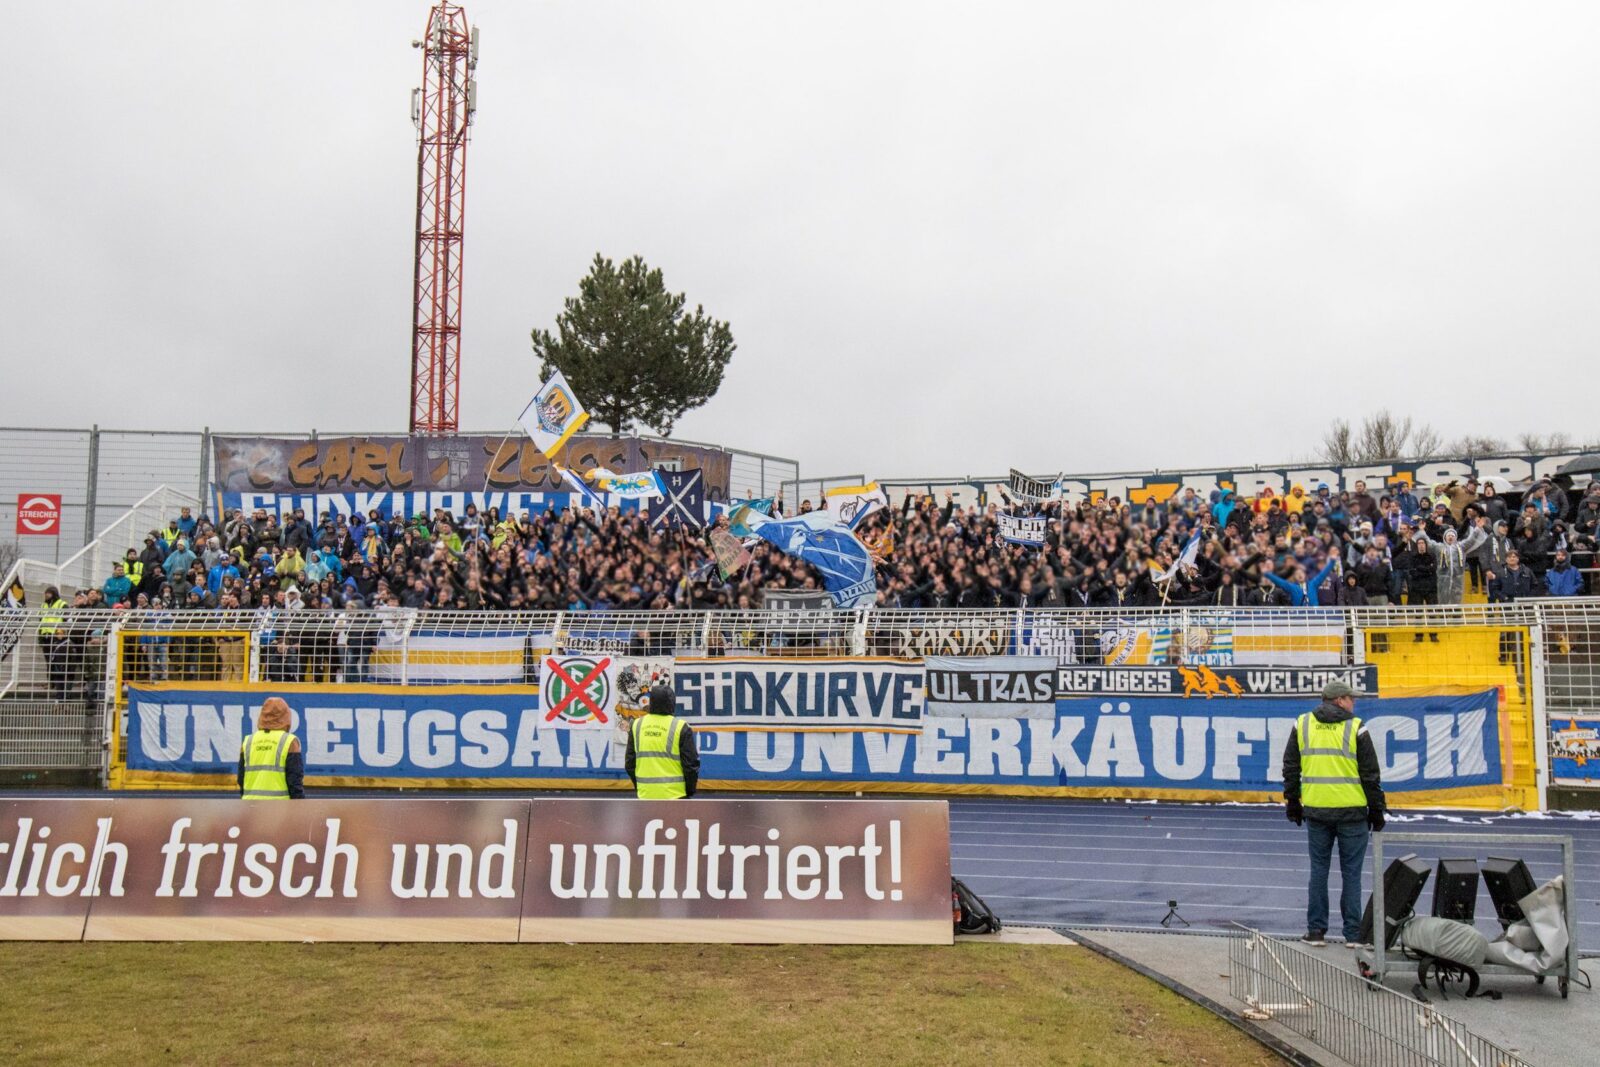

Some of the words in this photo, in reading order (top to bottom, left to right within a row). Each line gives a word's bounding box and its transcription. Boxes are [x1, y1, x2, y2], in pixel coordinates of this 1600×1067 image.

[288, 442, 413, 490] CARL
[19, 510, 58, 518] STREICHER
[674, 671, 924, 719] SÜDKURVE
[930, 672, 1053, 702] ULTRAS
[1058, 669, 1172, 692] REFUGEES
[1247, 669, 1367, 692] WELCOME
[138, 702, 627, 770] UNEUGSAM
[746, 702, 1488, 782] UNVERKÄUFCH
[155, 817, 359, 898] frisch
[391, 818, 517, 898] und
[549, 818, 903, 901] unfiltriert!
